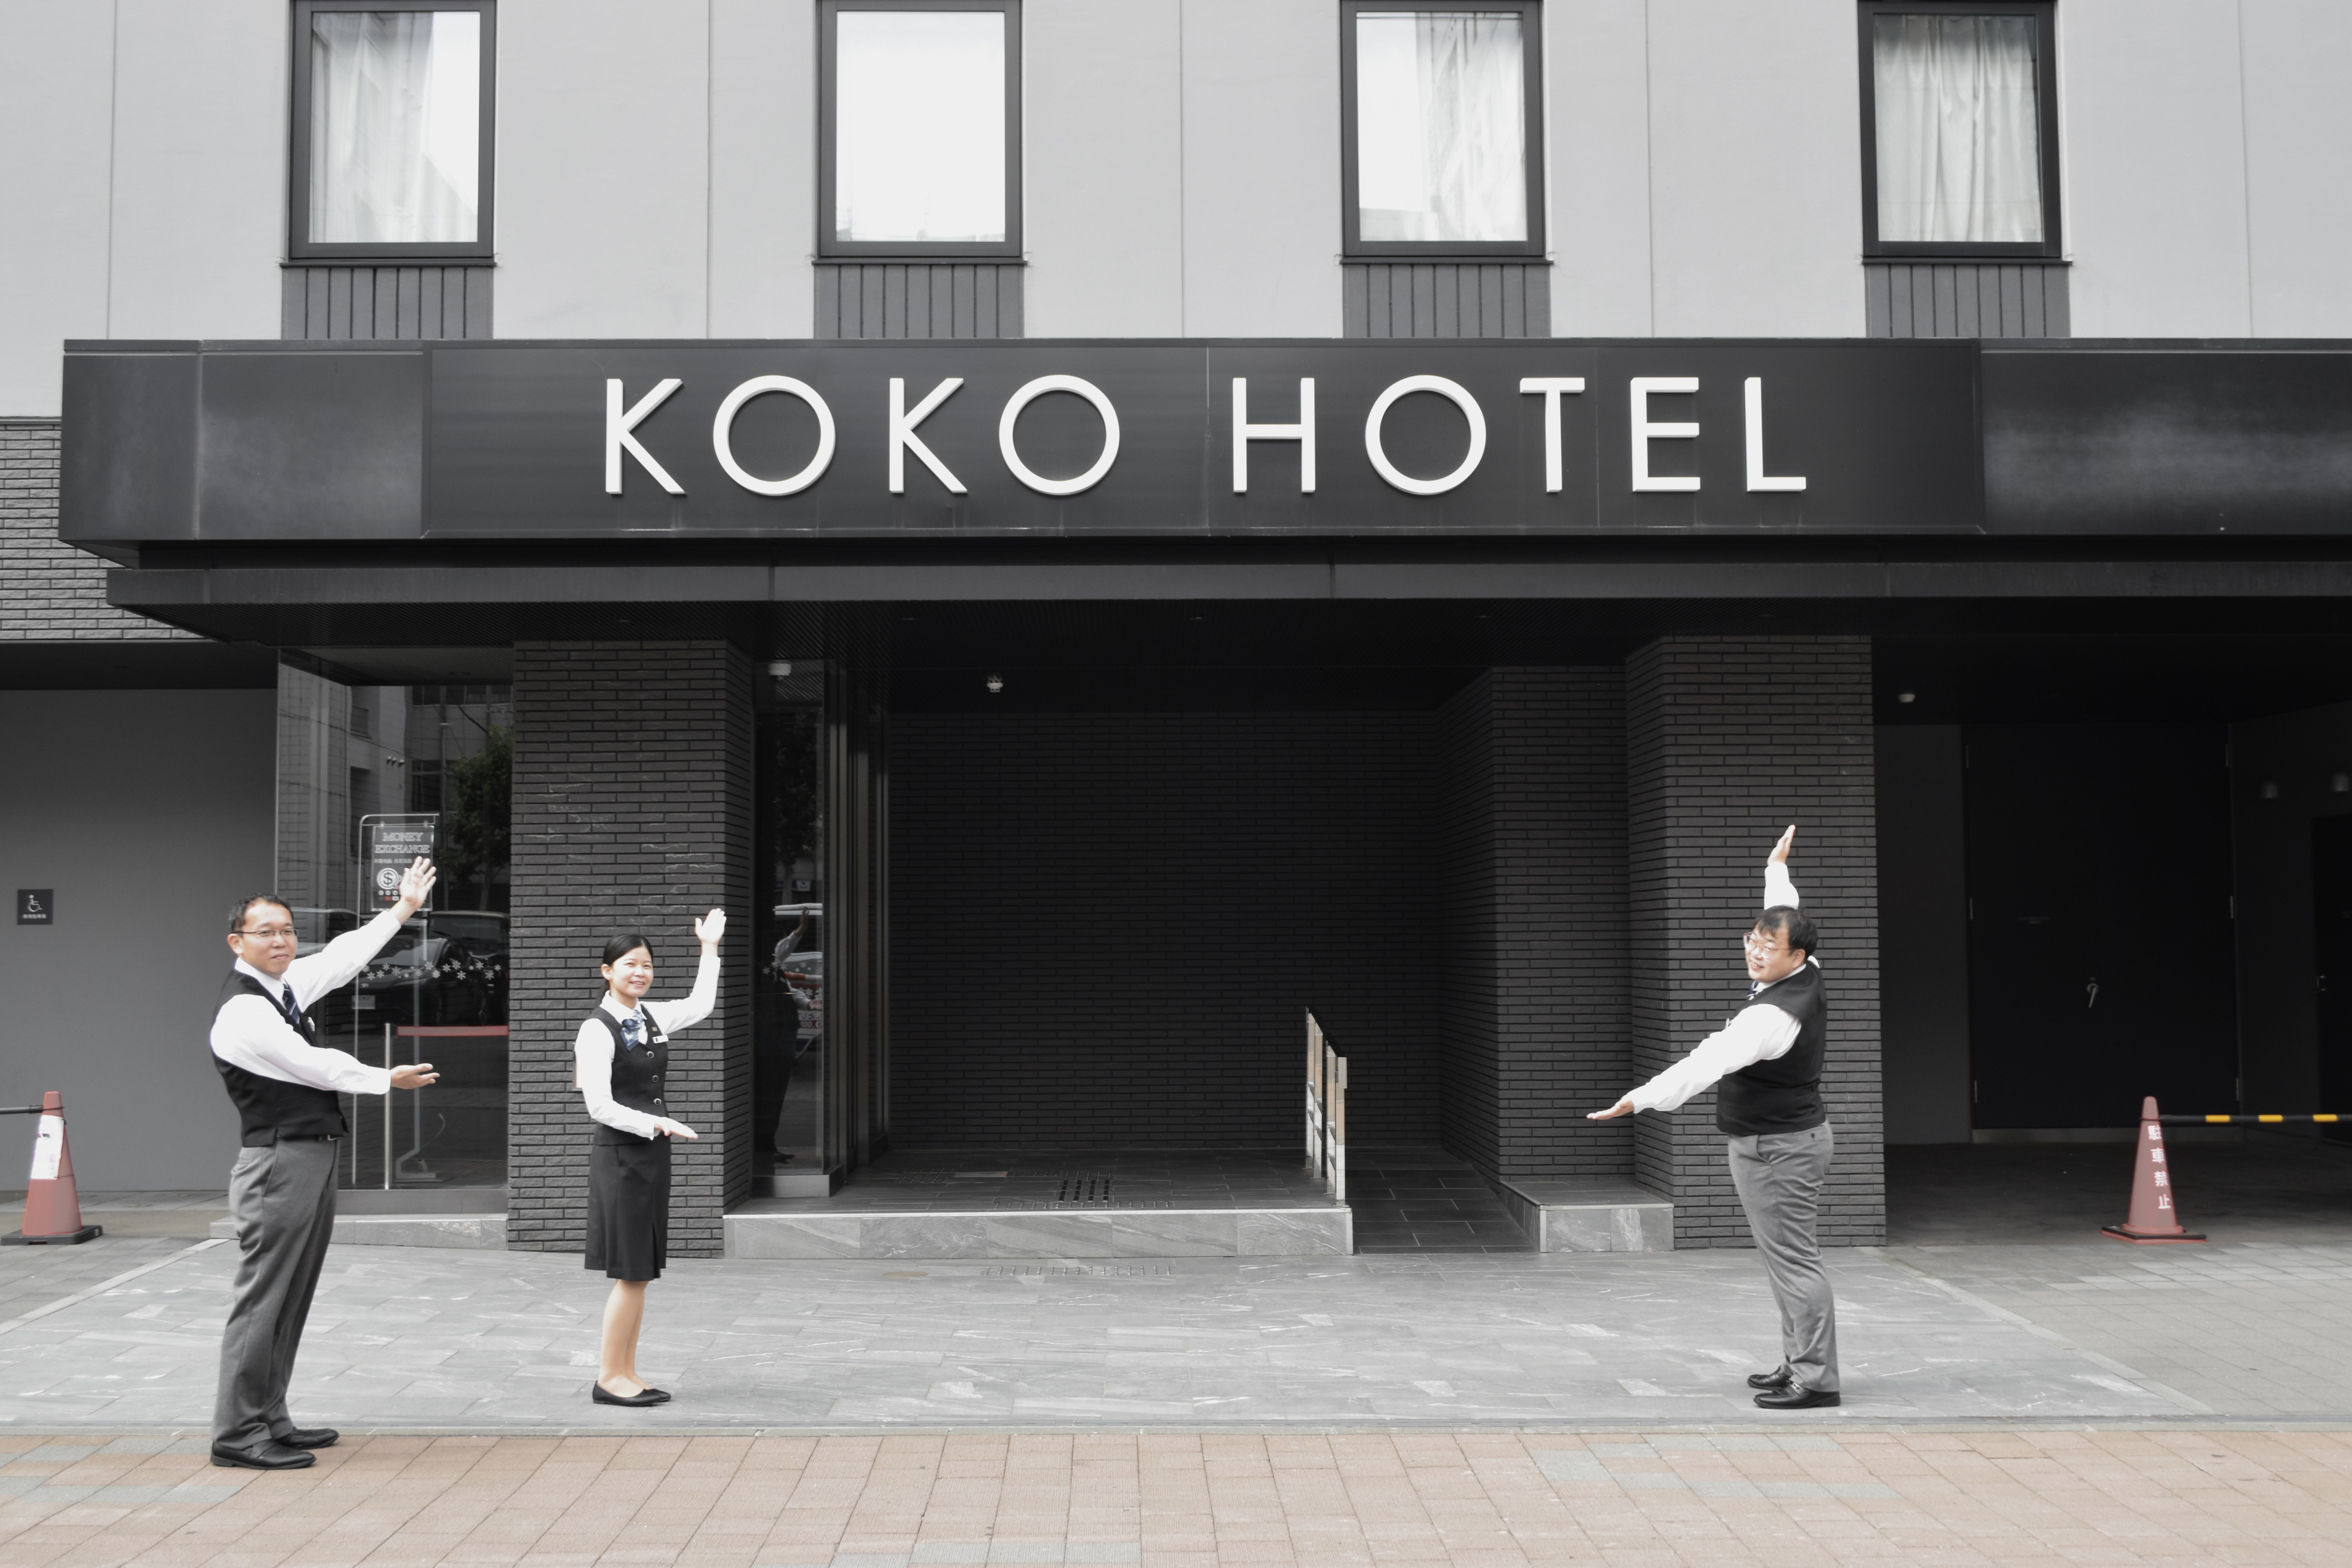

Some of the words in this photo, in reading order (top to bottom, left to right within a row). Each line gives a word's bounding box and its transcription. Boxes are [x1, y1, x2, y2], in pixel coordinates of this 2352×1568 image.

[606, 375, 1120, 495] KOKO
[1233, 375, 1806, 495] HOTEL
[375, 845, 430, 853] EXCHANGE
[383, 833, 423, 841] MONEY
[2148, 1125, 2171, 1209] 駐車禁止
